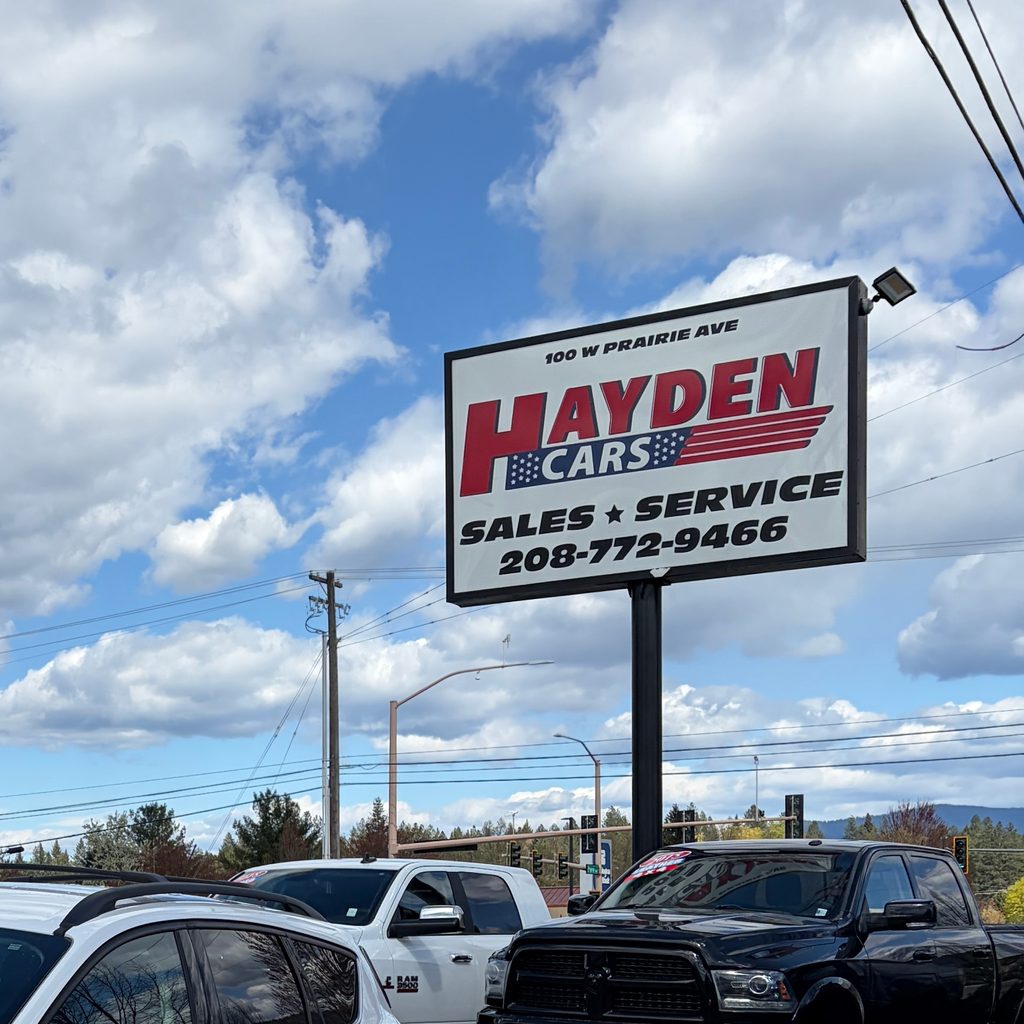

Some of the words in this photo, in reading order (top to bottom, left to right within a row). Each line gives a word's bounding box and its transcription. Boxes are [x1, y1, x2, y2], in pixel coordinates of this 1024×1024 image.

[545, 348, 577, 364] 100
[581, 344, 599, 357] W
[603, 328, 692, 354] PRAIRIE
[694, 319, 739, 338] AVE
[460, 347, 821, 497] HAYDEN
[541, 436, 653, 481] CARS
[459, 504, 595, 545] SALES
[634, 470, 844, 522] SERVICE
[498, 516, 789, 576] 208-772-9466
